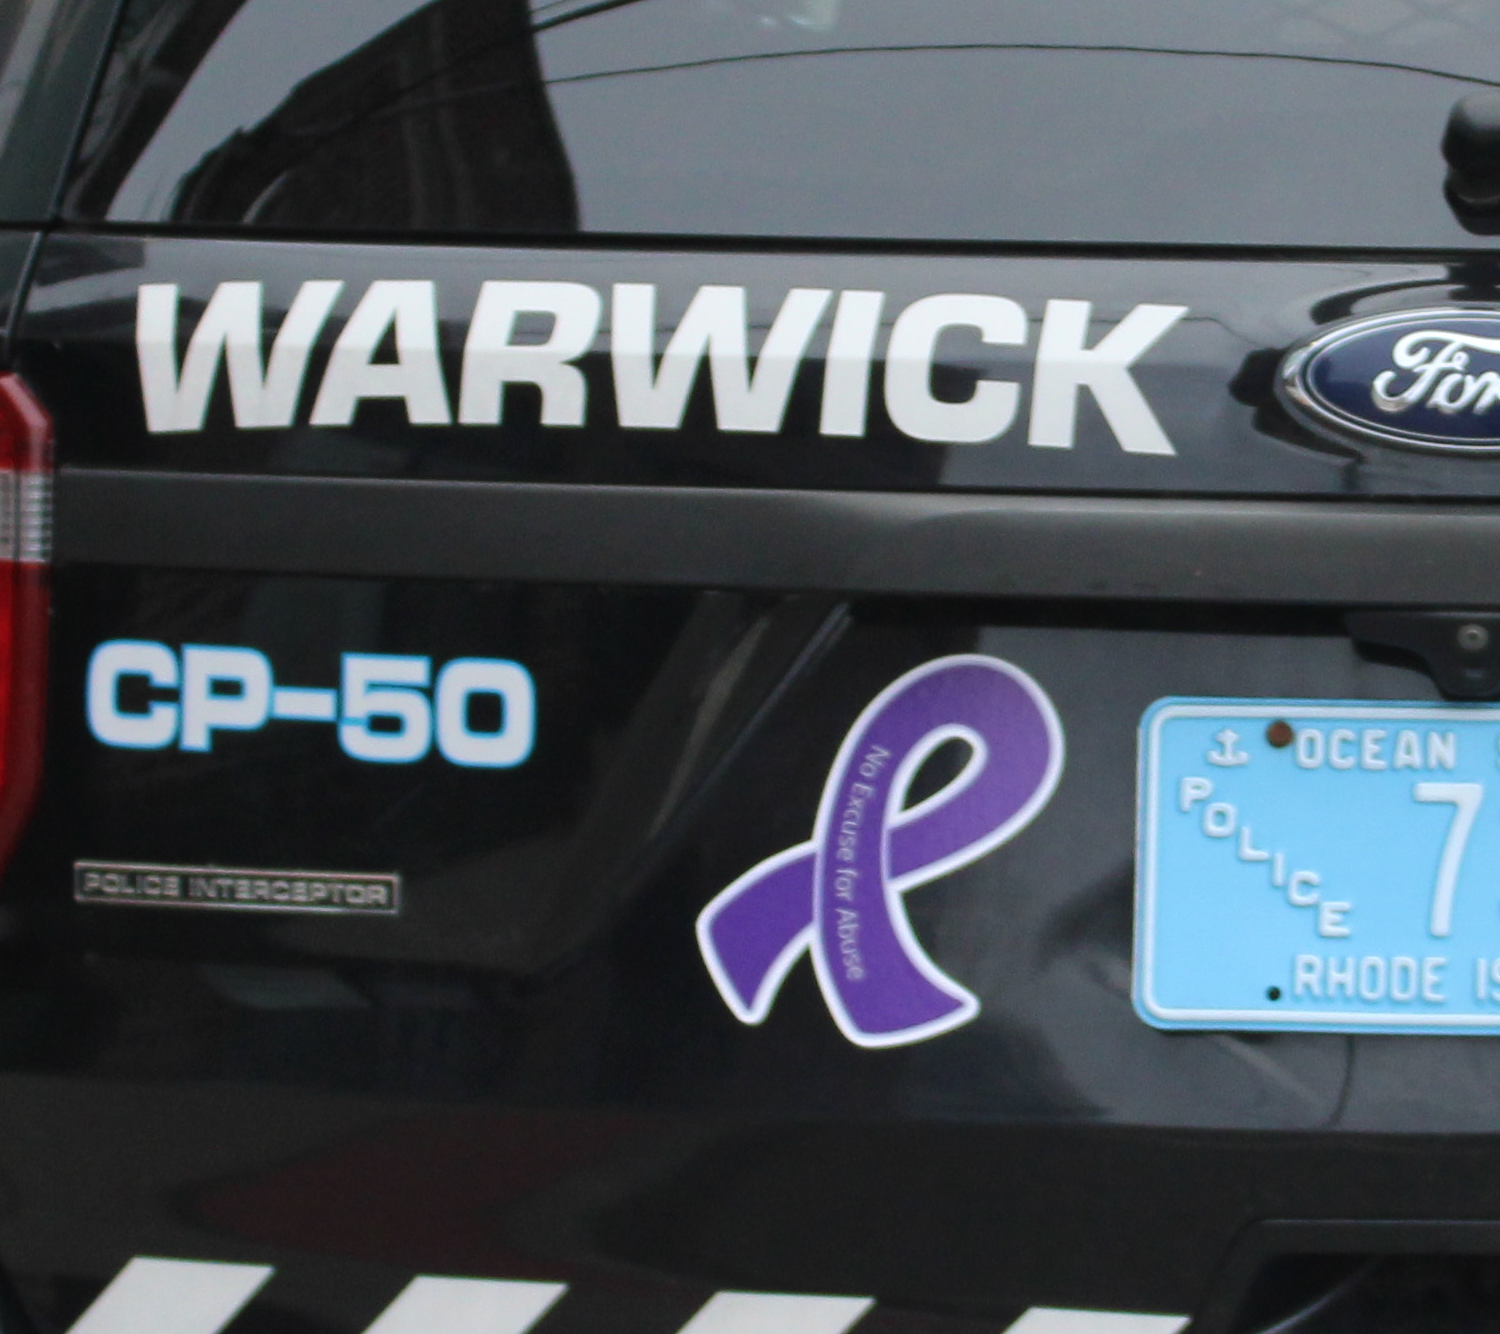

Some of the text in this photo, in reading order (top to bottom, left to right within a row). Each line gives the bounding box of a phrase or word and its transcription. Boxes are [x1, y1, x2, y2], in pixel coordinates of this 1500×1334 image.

[135, 279, 1190, 457] WARWICK
[85, 639, 536, 768] CP-50
[1294, 727, 1457, 770] OCEAN
[83, 871, 388, 905] POLICE INTERCEPTOR
[834, 743, 892, 982] No Excuse for Abuse
[1179, 776, 1352, 938] POLICE
[1294, 954, 1448, 1004] RHODE
